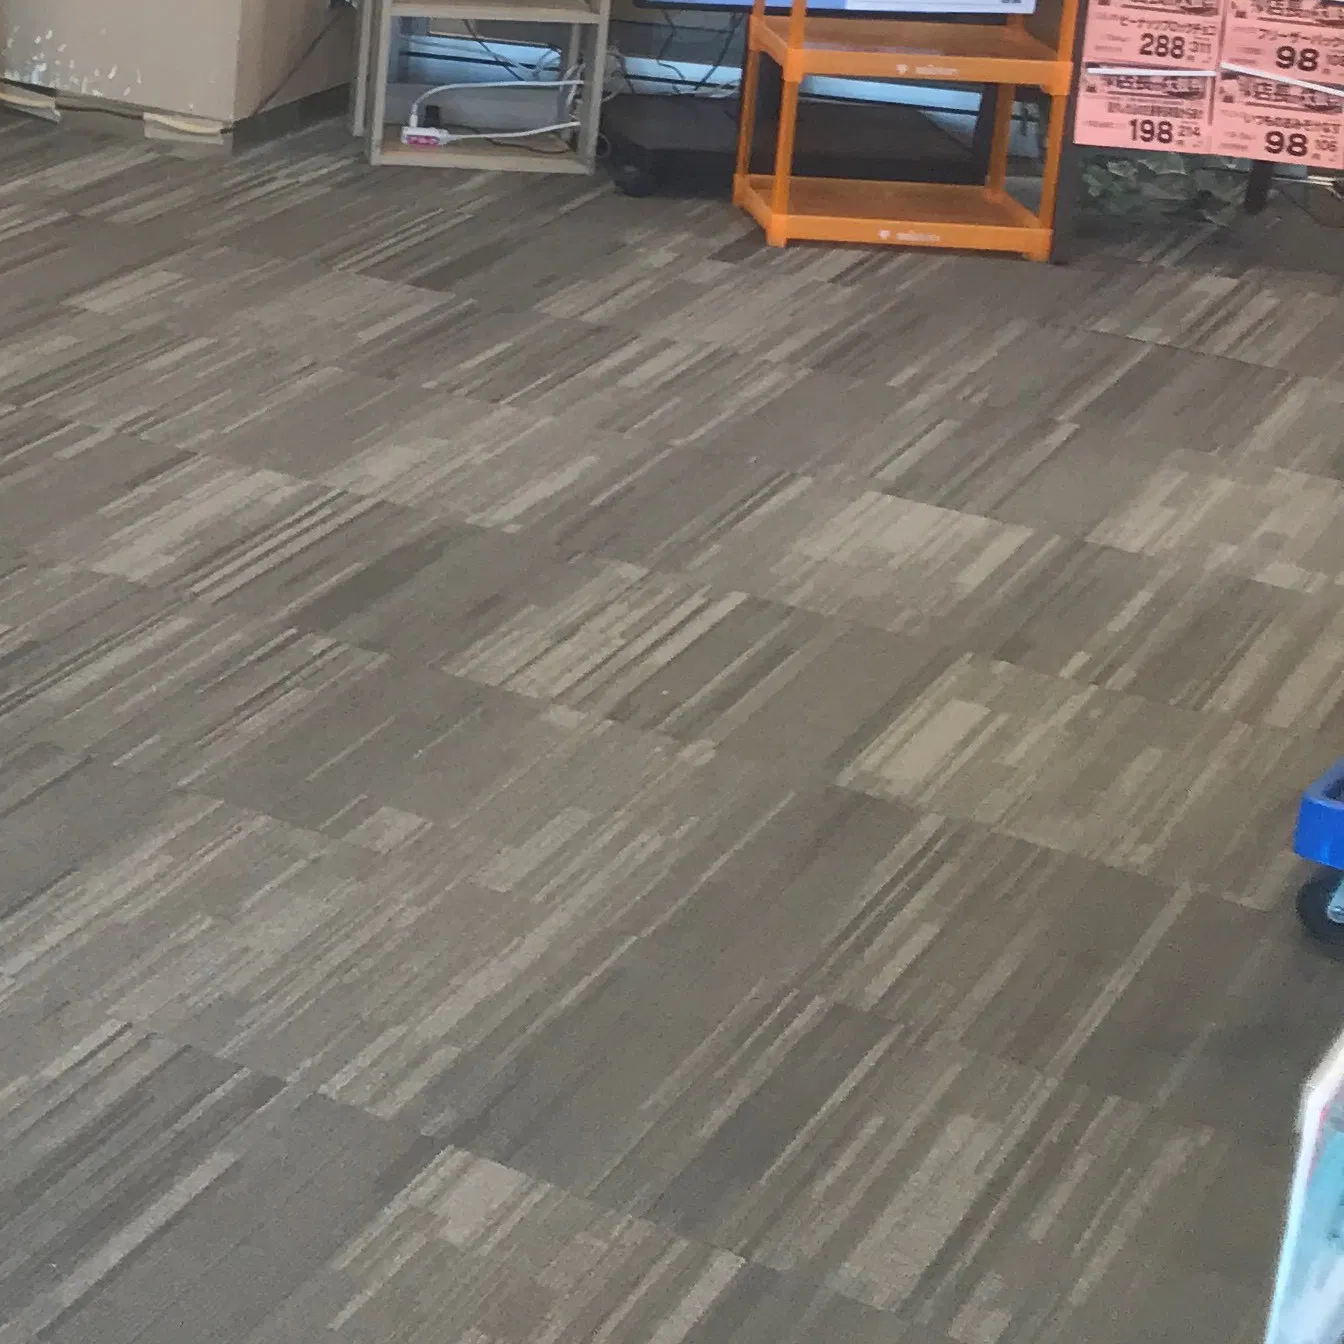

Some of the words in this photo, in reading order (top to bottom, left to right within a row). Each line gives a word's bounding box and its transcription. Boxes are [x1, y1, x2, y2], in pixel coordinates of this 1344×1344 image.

[1139, 32, 1187, 60] 288
[1275, 44, 1321, 73] 98
[1128, 118, 1174, 145] 198
[1264, 130, 1309, 158] 98
